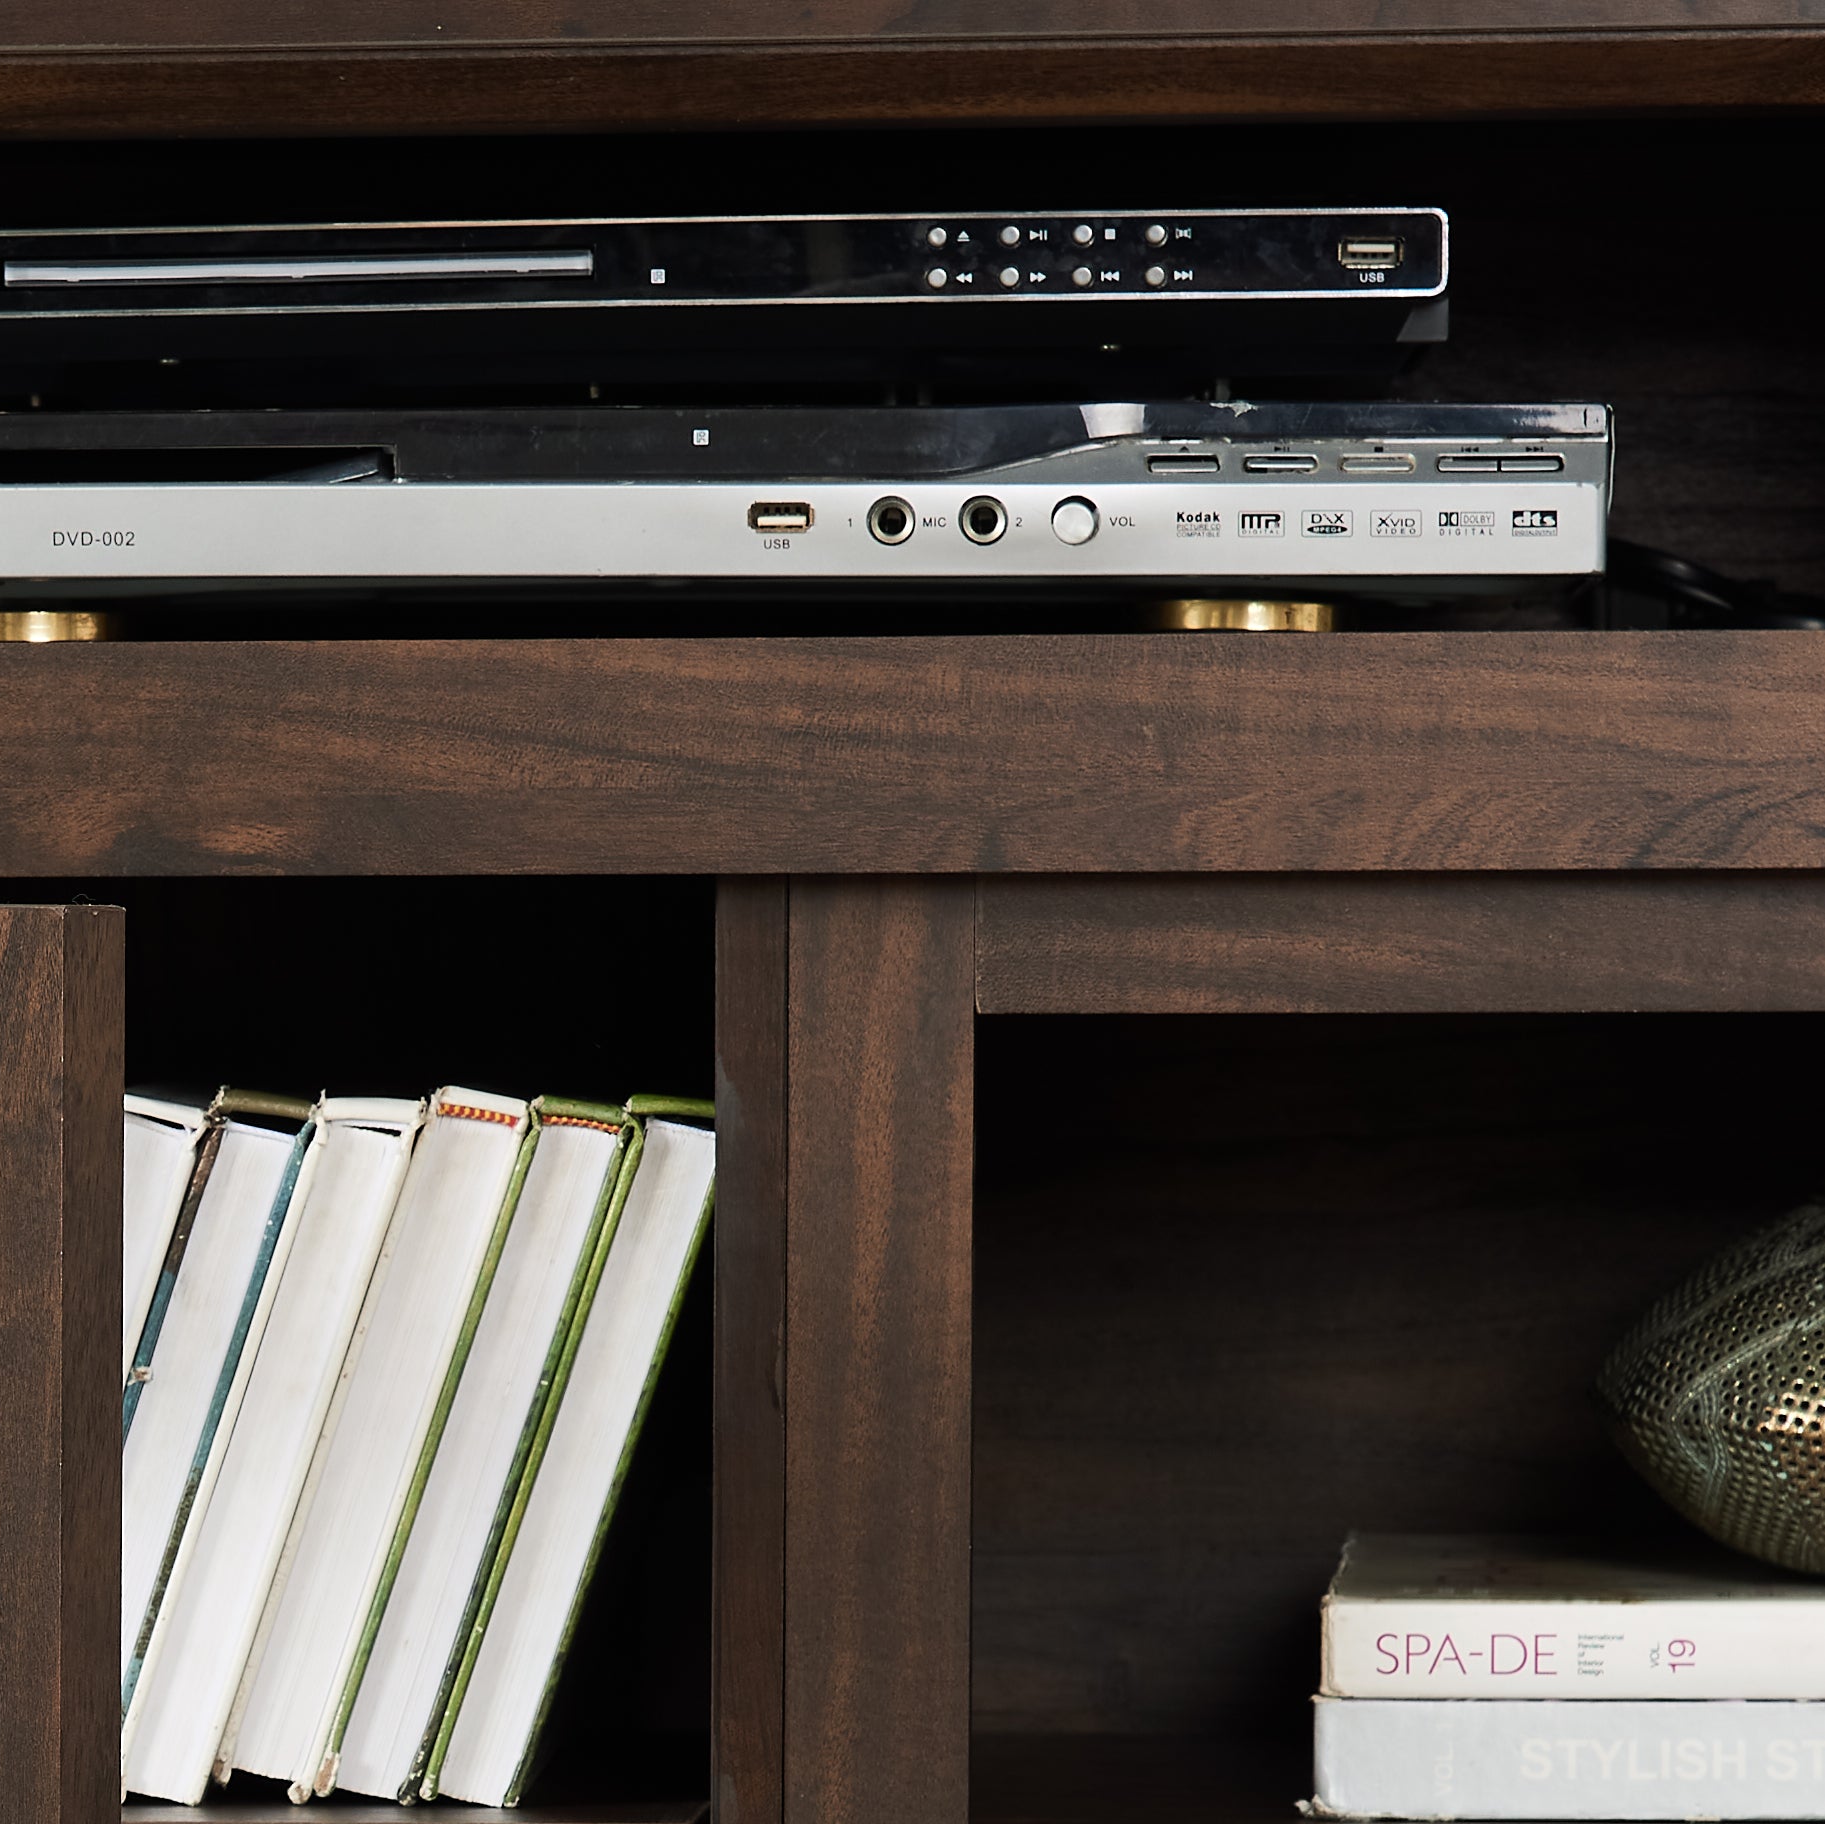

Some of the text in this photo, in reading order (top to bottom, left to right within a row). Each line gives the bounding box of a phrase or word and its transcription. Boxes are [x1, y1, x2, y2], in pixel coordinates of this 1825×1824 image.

[1359, 272, 1385, 283] USB
[847, 517, 853, 527] 1
[922, 517, 946, 527] MIC
[1015, 517, 1023, 527] 2
[1109, 517, 1136, 527] VOL
[1177, 511, 1220, 522] Kodak
[1463, 514, 1492, 524] DOLBY
[1514, 511, 1556, 527] dts
[1439, 528, 1494, 536] DIGITAL
[52, 530, 136, 548] DVD-002
[763, 538, 790, 550] USB
[1375, 1633, 1558, 1675] SPA-DE
[1668, 1639, 1696, 1673] 19
[1520, 1737, 1747, 1781] STYLISH
